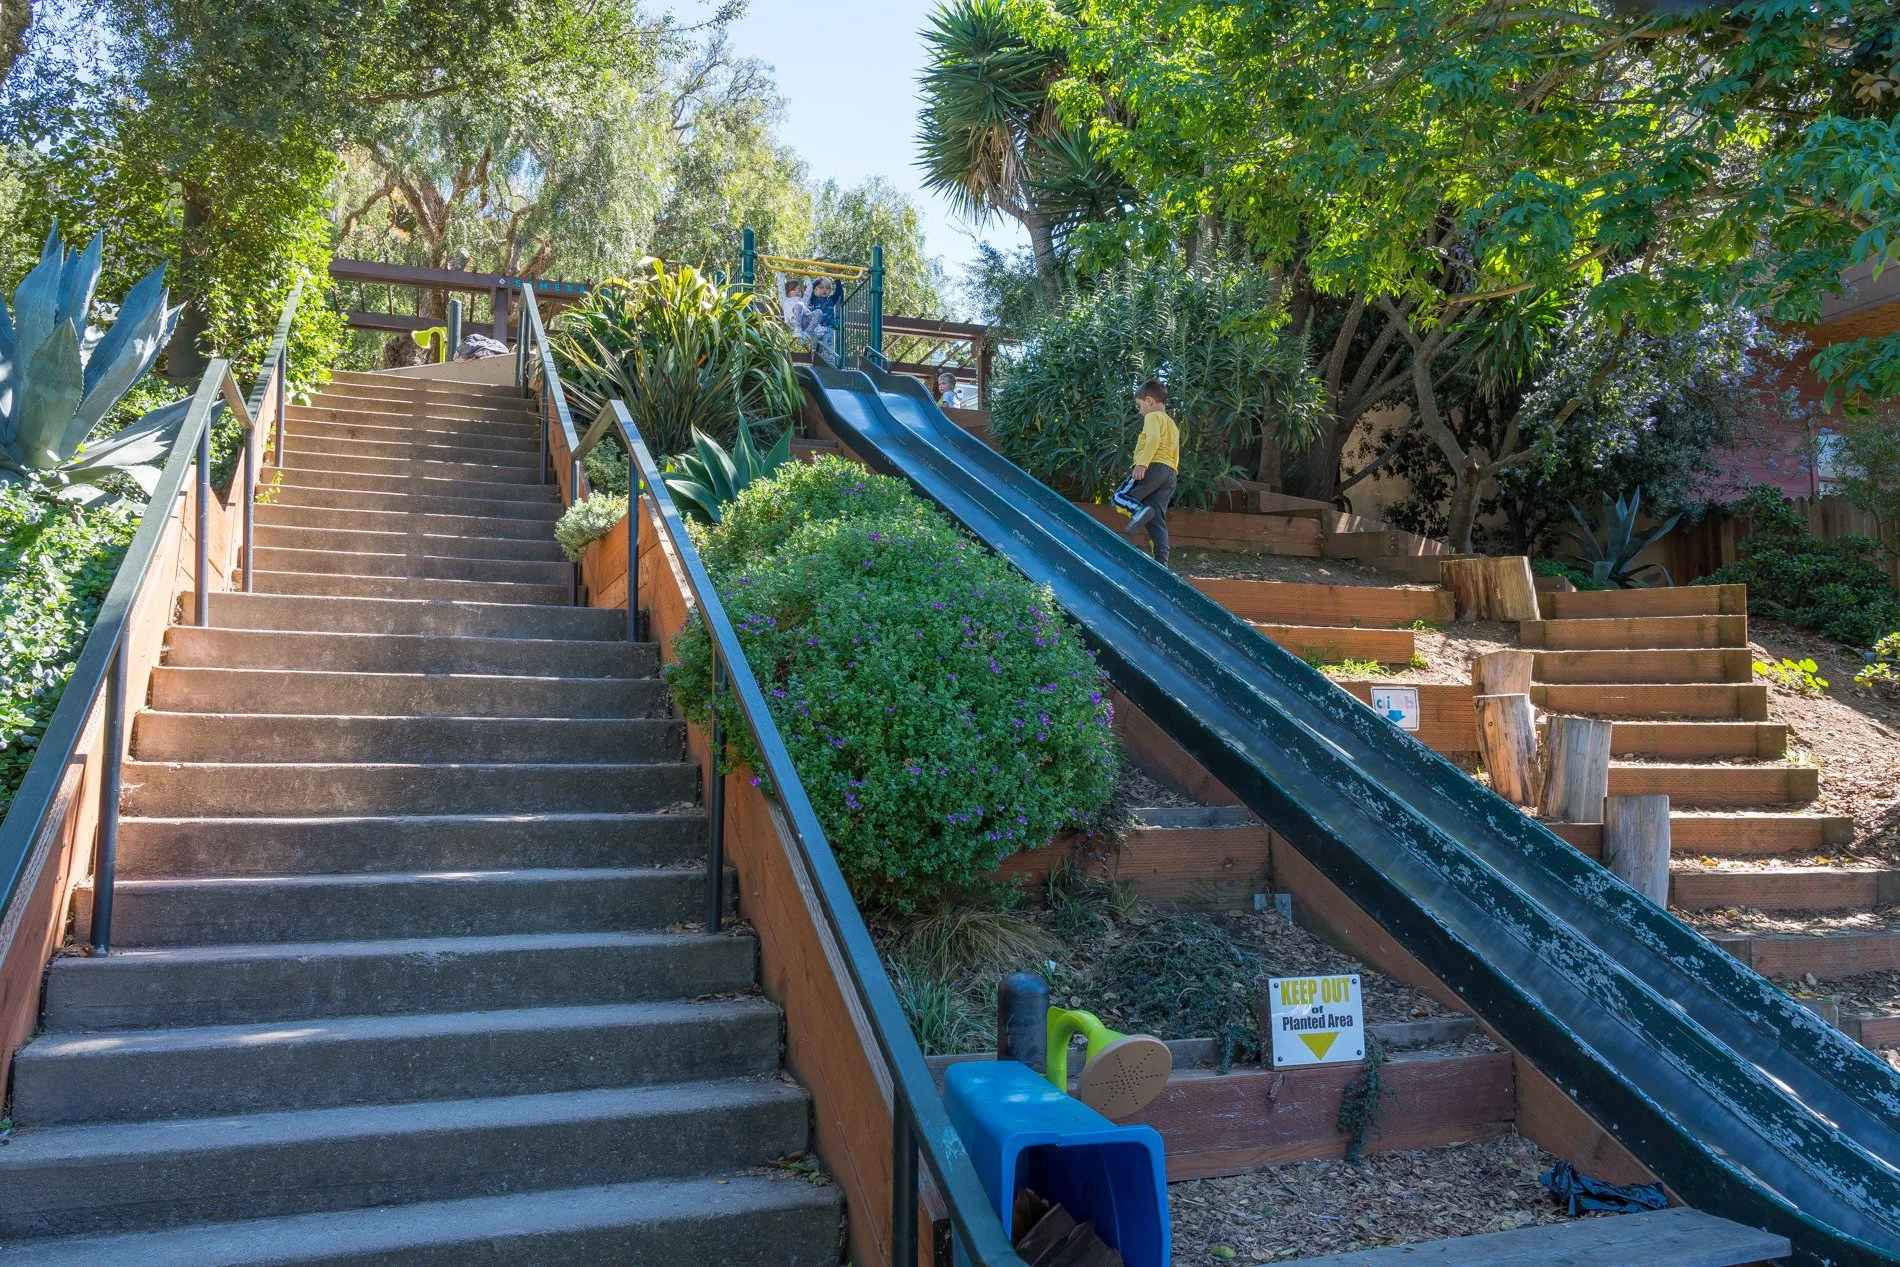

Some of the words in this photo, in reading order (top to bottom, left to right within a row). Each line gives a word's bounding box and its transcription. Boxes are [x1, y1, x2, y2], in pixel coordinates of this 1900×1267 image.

[515, 279, 611, 297] EMERAD
[1280, 980, 1317, 1005] KEEP
[1321, 977, 1350, 1004] OUT
[1311, 1005, 1324, 1014] of
[1282, 1014, 1326, 1031] Planted
[1328, 1014, 1353, 1029] Area
